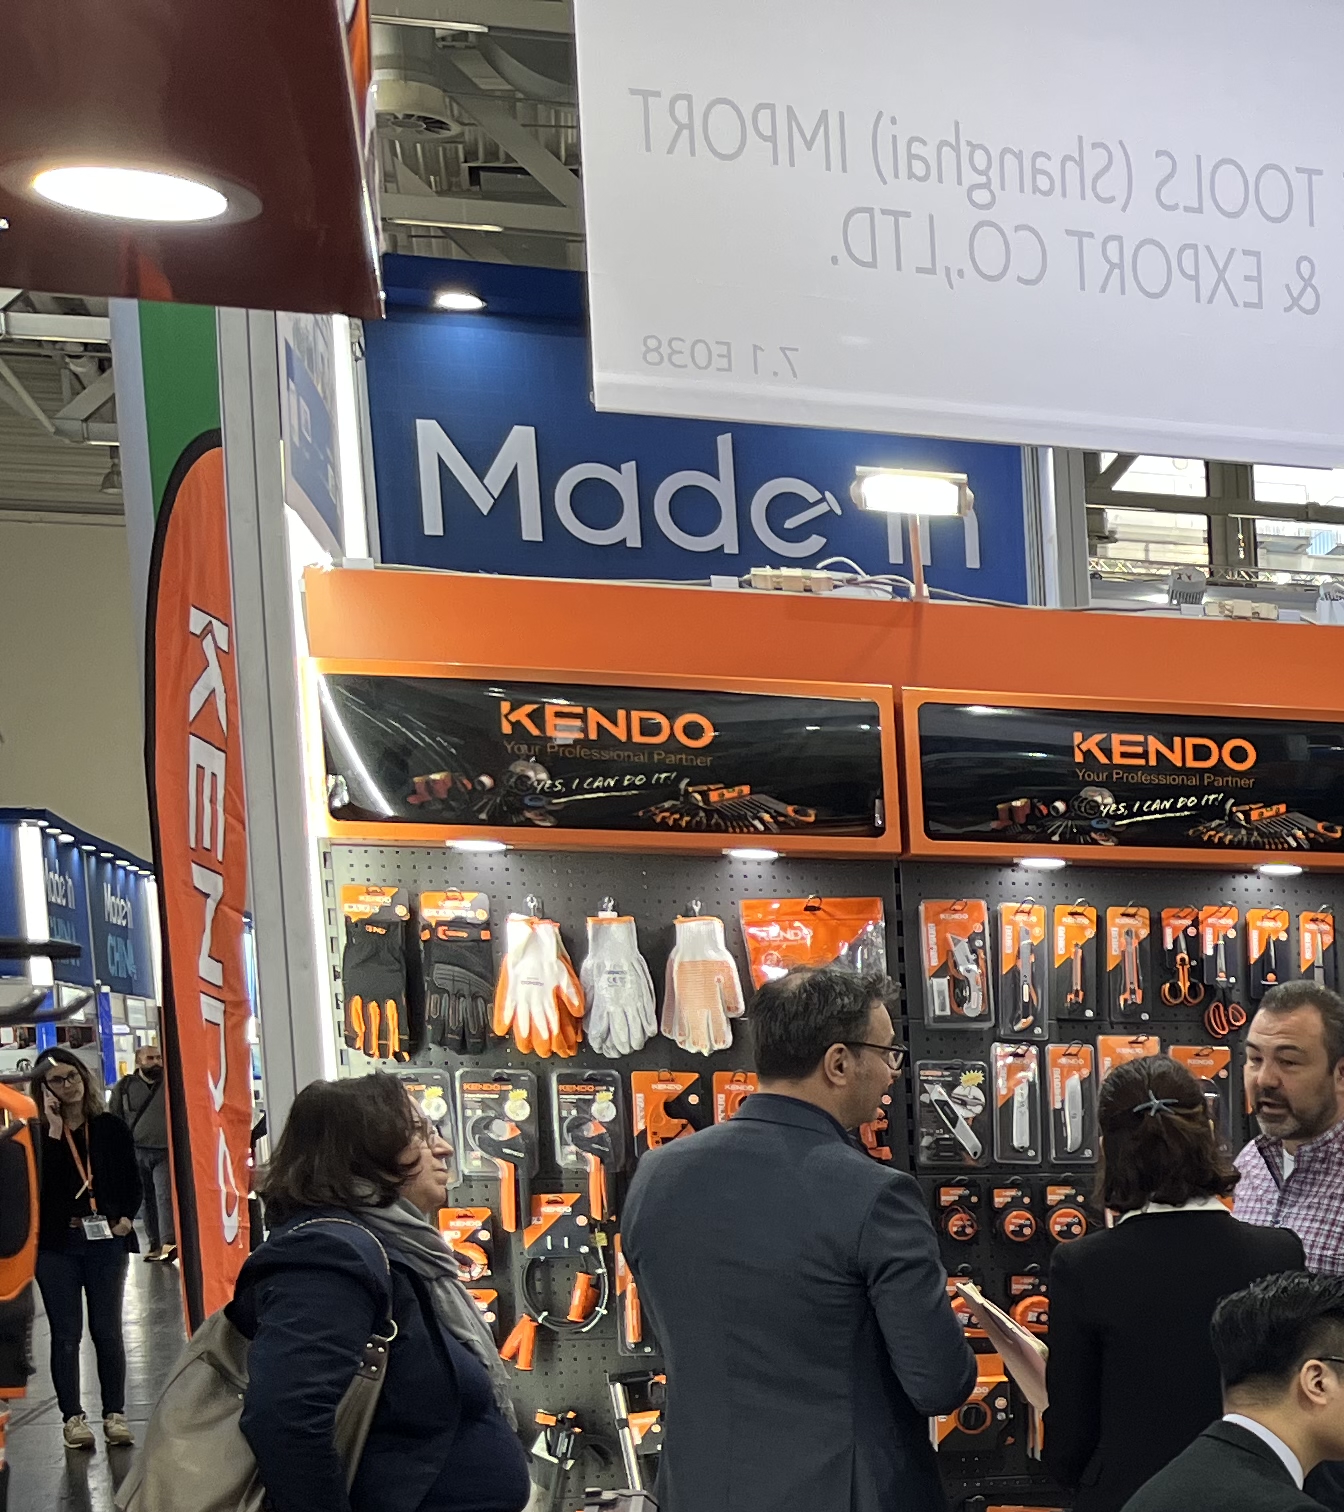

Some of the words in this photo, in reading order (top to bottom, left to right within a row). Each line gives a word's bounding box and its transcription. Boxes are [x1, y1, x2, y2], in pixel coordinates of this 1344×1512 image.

[414, 419, 843, 559] Made
[500, 701, 715, 748] KENDO
[503, 740, 543, 758] Your
[546, 742, 650, 765] Professional
[653, 749, 714, 768] Partner
[1072, 731, 1258, 771] KENDO
[1075, 768, 1109, 783] Your
[1112, 769, 1199, 787] Professional
[1202, 773, 1256, 789] Partner
[1142, 799, 1173, 813] CAN
[1176, 797, 1197, 809] DO
[463, 1083, 501, 1092] KENDO
[651, 1083, 684, 1091] KENDO
[724, 1083, 755, 1092] KENDO
[541, 1205, 572, 1214] KENDO
